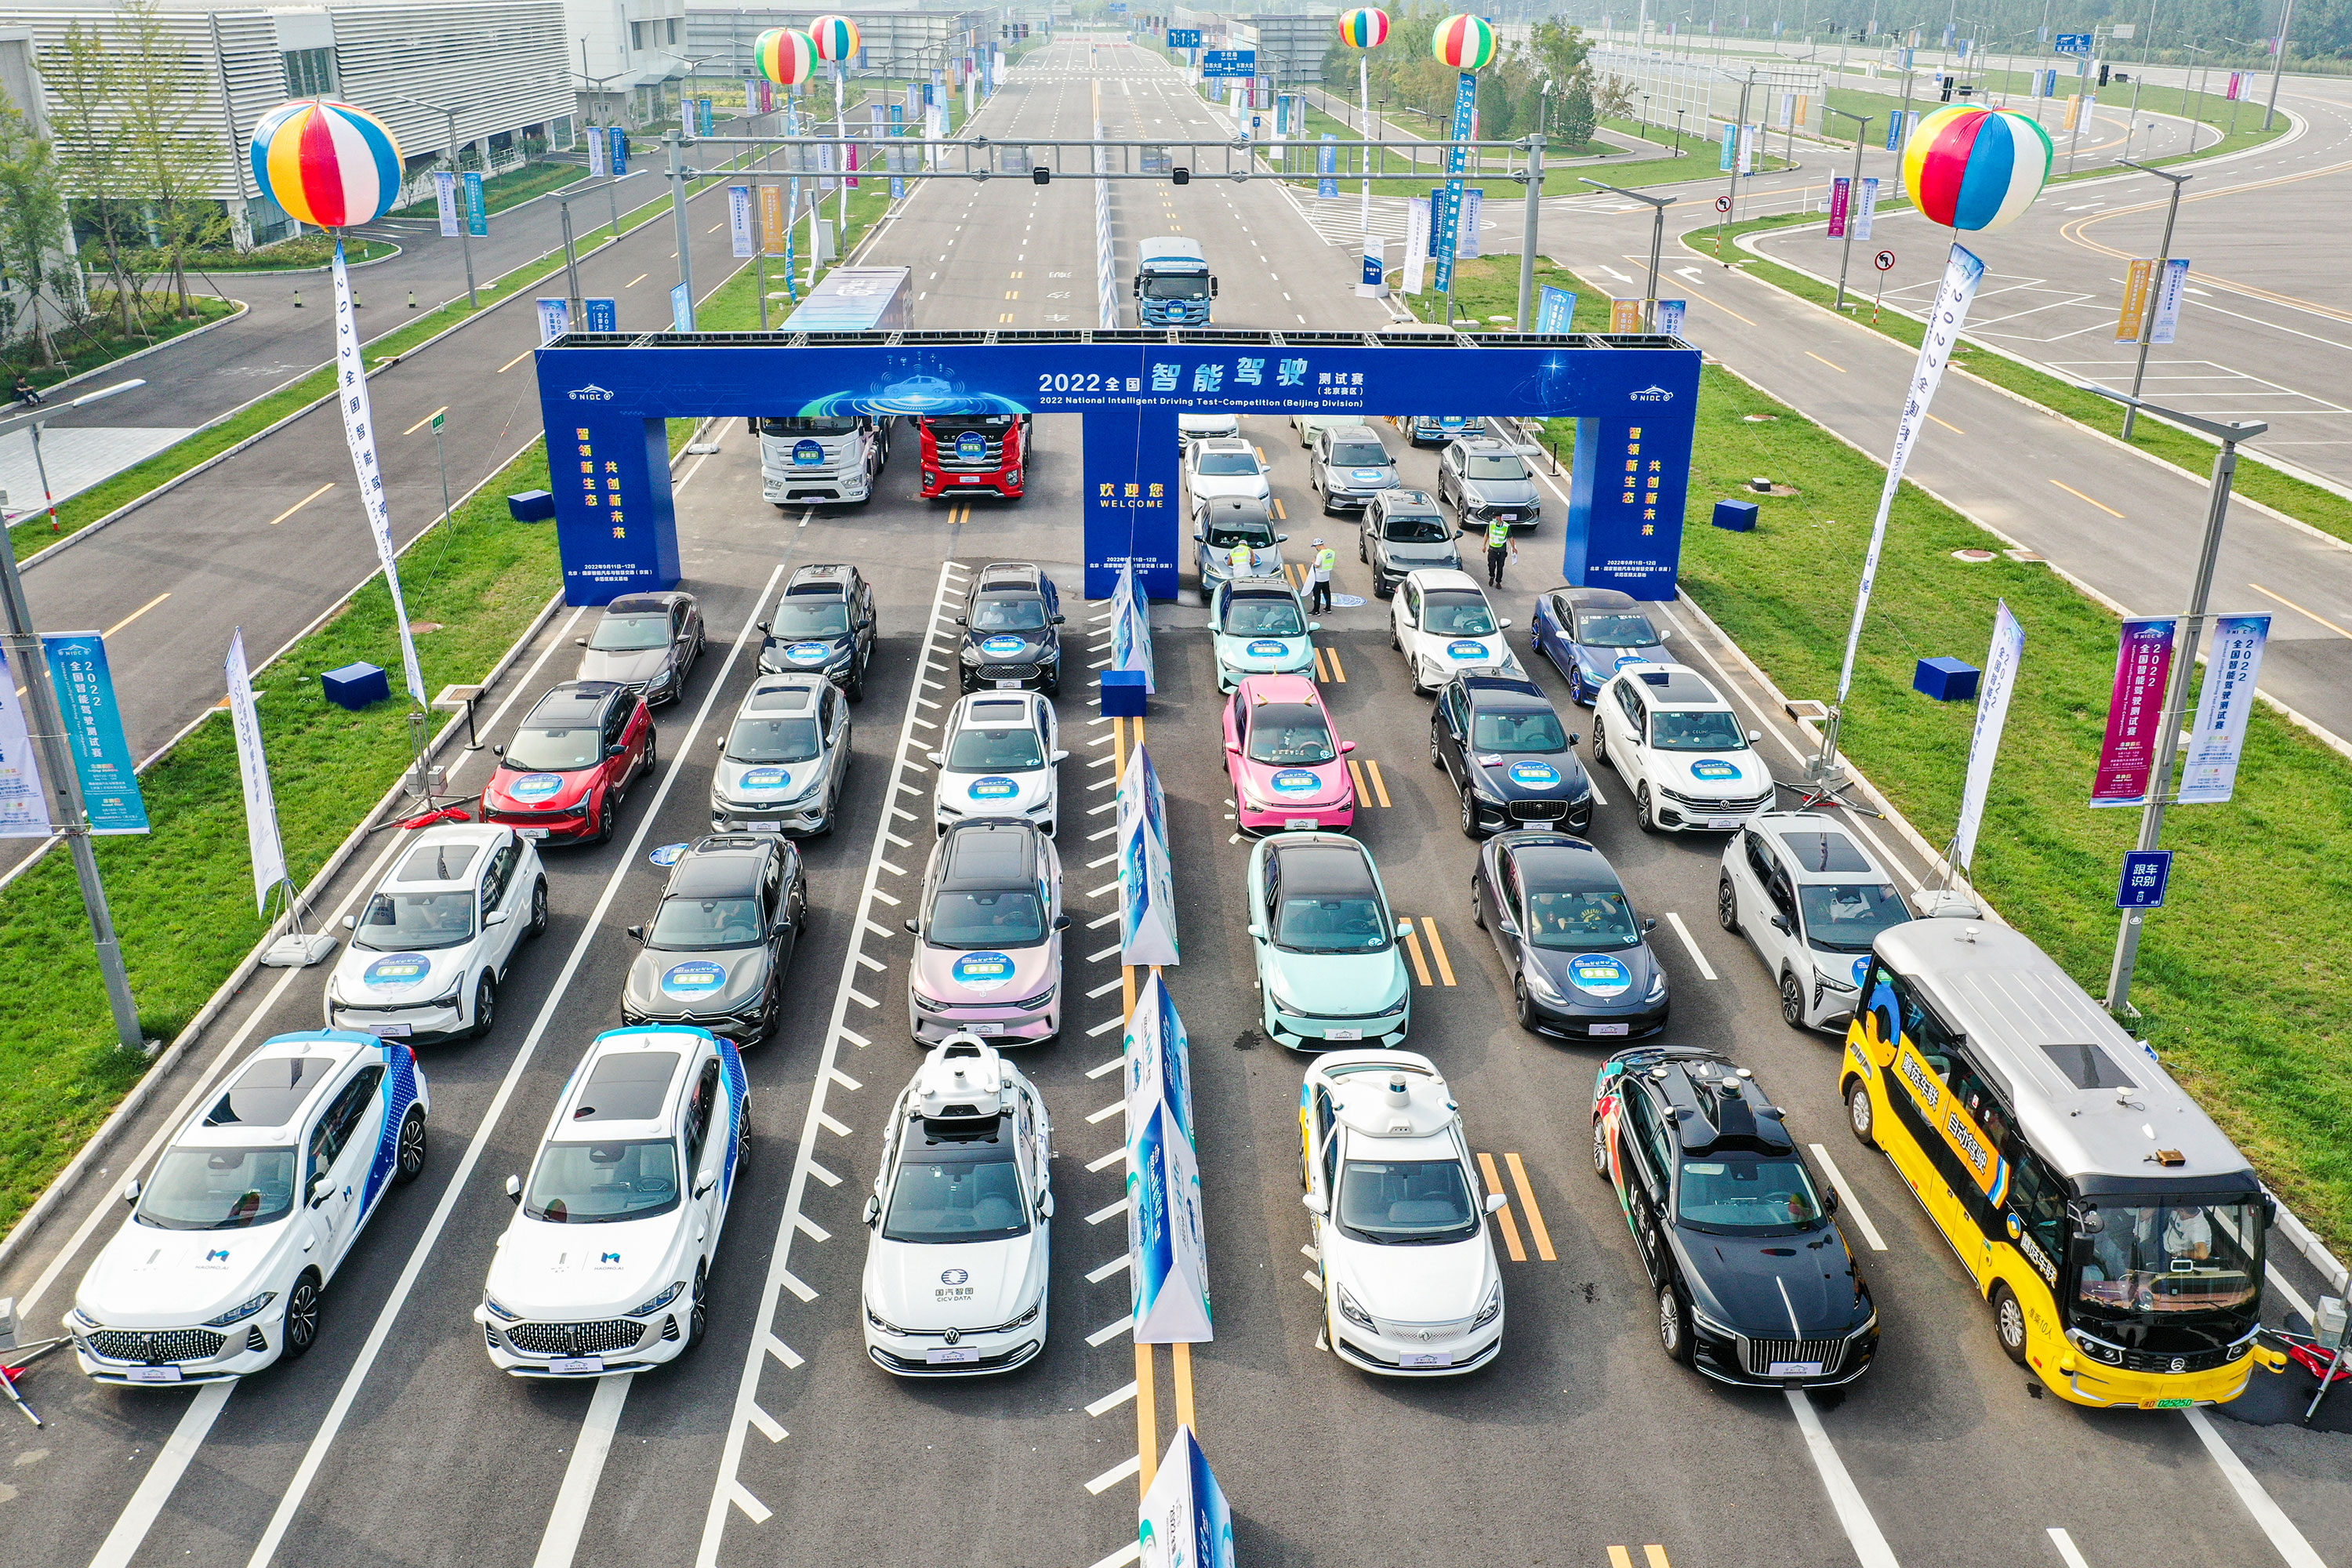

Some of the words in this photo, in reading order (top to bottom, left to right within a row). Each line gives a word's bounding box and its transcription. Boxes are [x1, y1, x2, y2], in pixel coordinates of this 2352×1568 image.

[1108, 397, 1157, 407] Intelligent
[1160, 398, 1193, 408] Driving
[1196, 398, 1280, 408] Test-Competition
[1283, 399, 1319, 408] (Beijing
[1323, 400, 1363, 408] Division)
[576, 427, 598, 506] 智领新生态
[1099, 483, 1164, 497] 欢迎您
[1622, 426, 1642, 503] 智领新生态
[605, 461, 626, 539] 共创新未来
[1642, 460, 1661, 536] 共创新未来
[85, 661, 102, 706] 2022
[2125, 644, 2150, 736] 全国智能驾驶测试赛
[2148, 644, 2161, 687] 2022
[2214, 639, 2243, 730] 全国智能驾驶测试赛
[2238, 639, 2255, 682] 2022
[70, 661, 103, 758] 全国智能驾驶测试赛
[2132, 876, 2155, 887] 识别
[2133, 864, 2158, 875] 跟车
[1947, 1112, 1988, 1176] 自动驾驶
